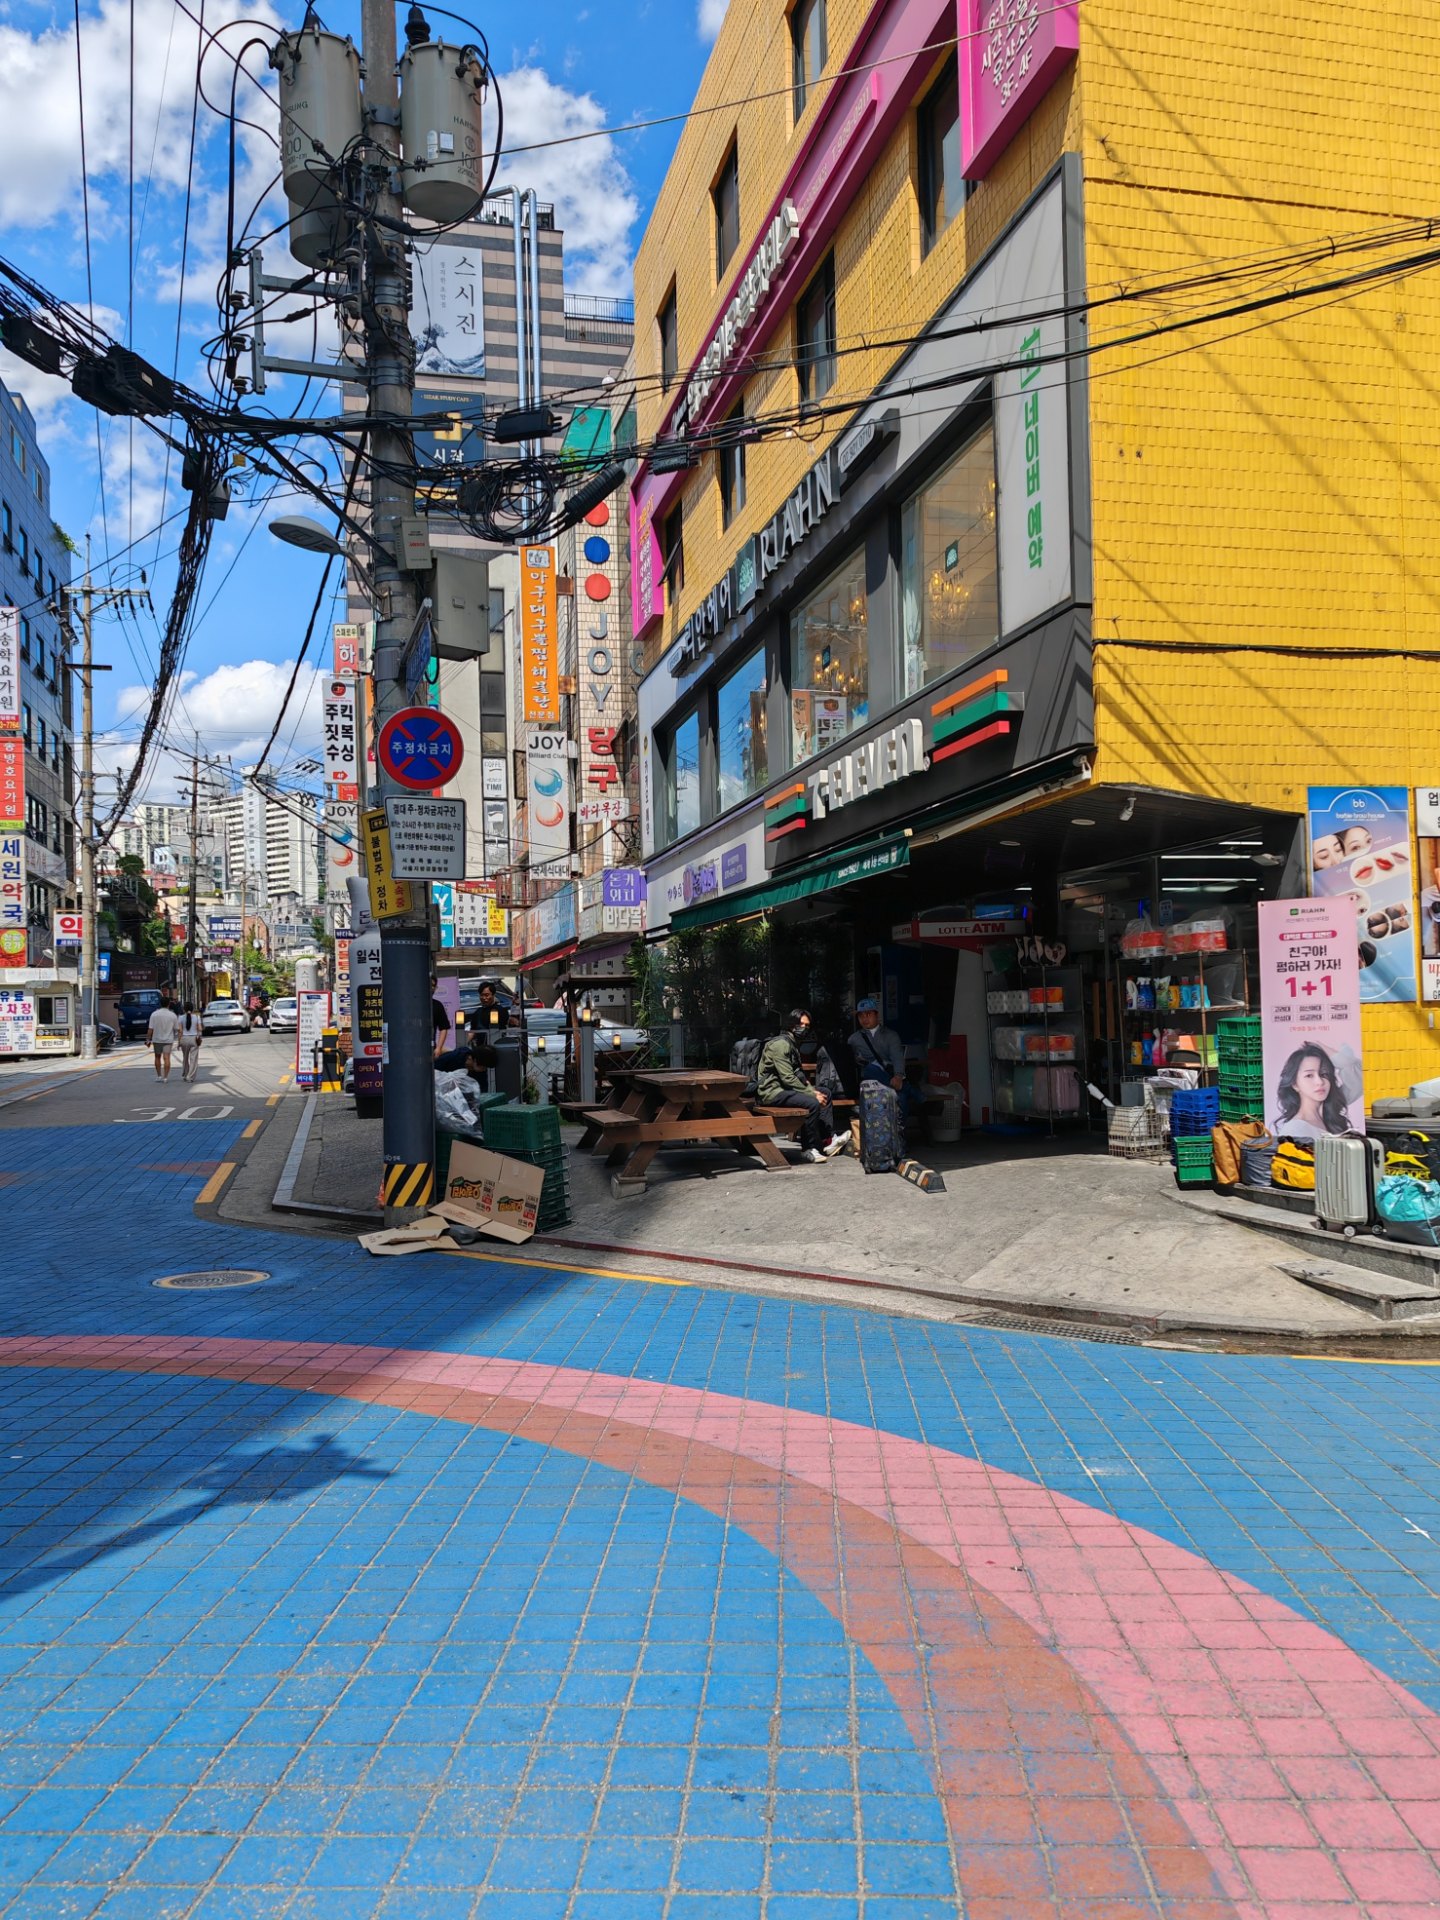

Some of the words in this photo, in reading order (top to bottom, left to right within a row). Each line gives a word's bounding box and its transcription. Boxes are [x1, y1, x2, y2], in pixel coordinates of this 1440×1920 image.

[454, 256, 477, 335] 스시진
[1024, 391, 1041, 498] 네이버
[760, 447, 839, 581] RIAHN
[1027, 501, 1043, 569] 예약
[684, 569, 732, 660] 리안헤어
[587, 612, 613, 712] JOY
[325, 703, 340, 762] 주짓수
[340, 703, 355, 762] 킥복싱
[392, 742, 451, 755] 주정차금지
[529, 736, 564, 750] JOY
[588, 727, 618, 792] 당구
[327, 805, 356, 817] JOY
[579, 800, 623, 820] 바다목장
[1352, 799, 1365, 808] bb
[531, 864, 570, 877] 국제식대대
[2, 839, 23, 923] 세원약국
[938, 926, 973, 935] LOTTE
[971, 922, 1006, 934] ATM
[357, 949, 380, 964] 일식
[1289, 945, 1327, 958] 친구야!
[1276, 960, 1310, 973] 펌하러
[1314, 958, 1341, 971] 가자!
[1285, 975, 1332, 997] 1+1
[0, 990, 24, 1003] 유료
[359, 1065, 375, 1073] OPEN
[111, 1105, 235, 1122] 30
